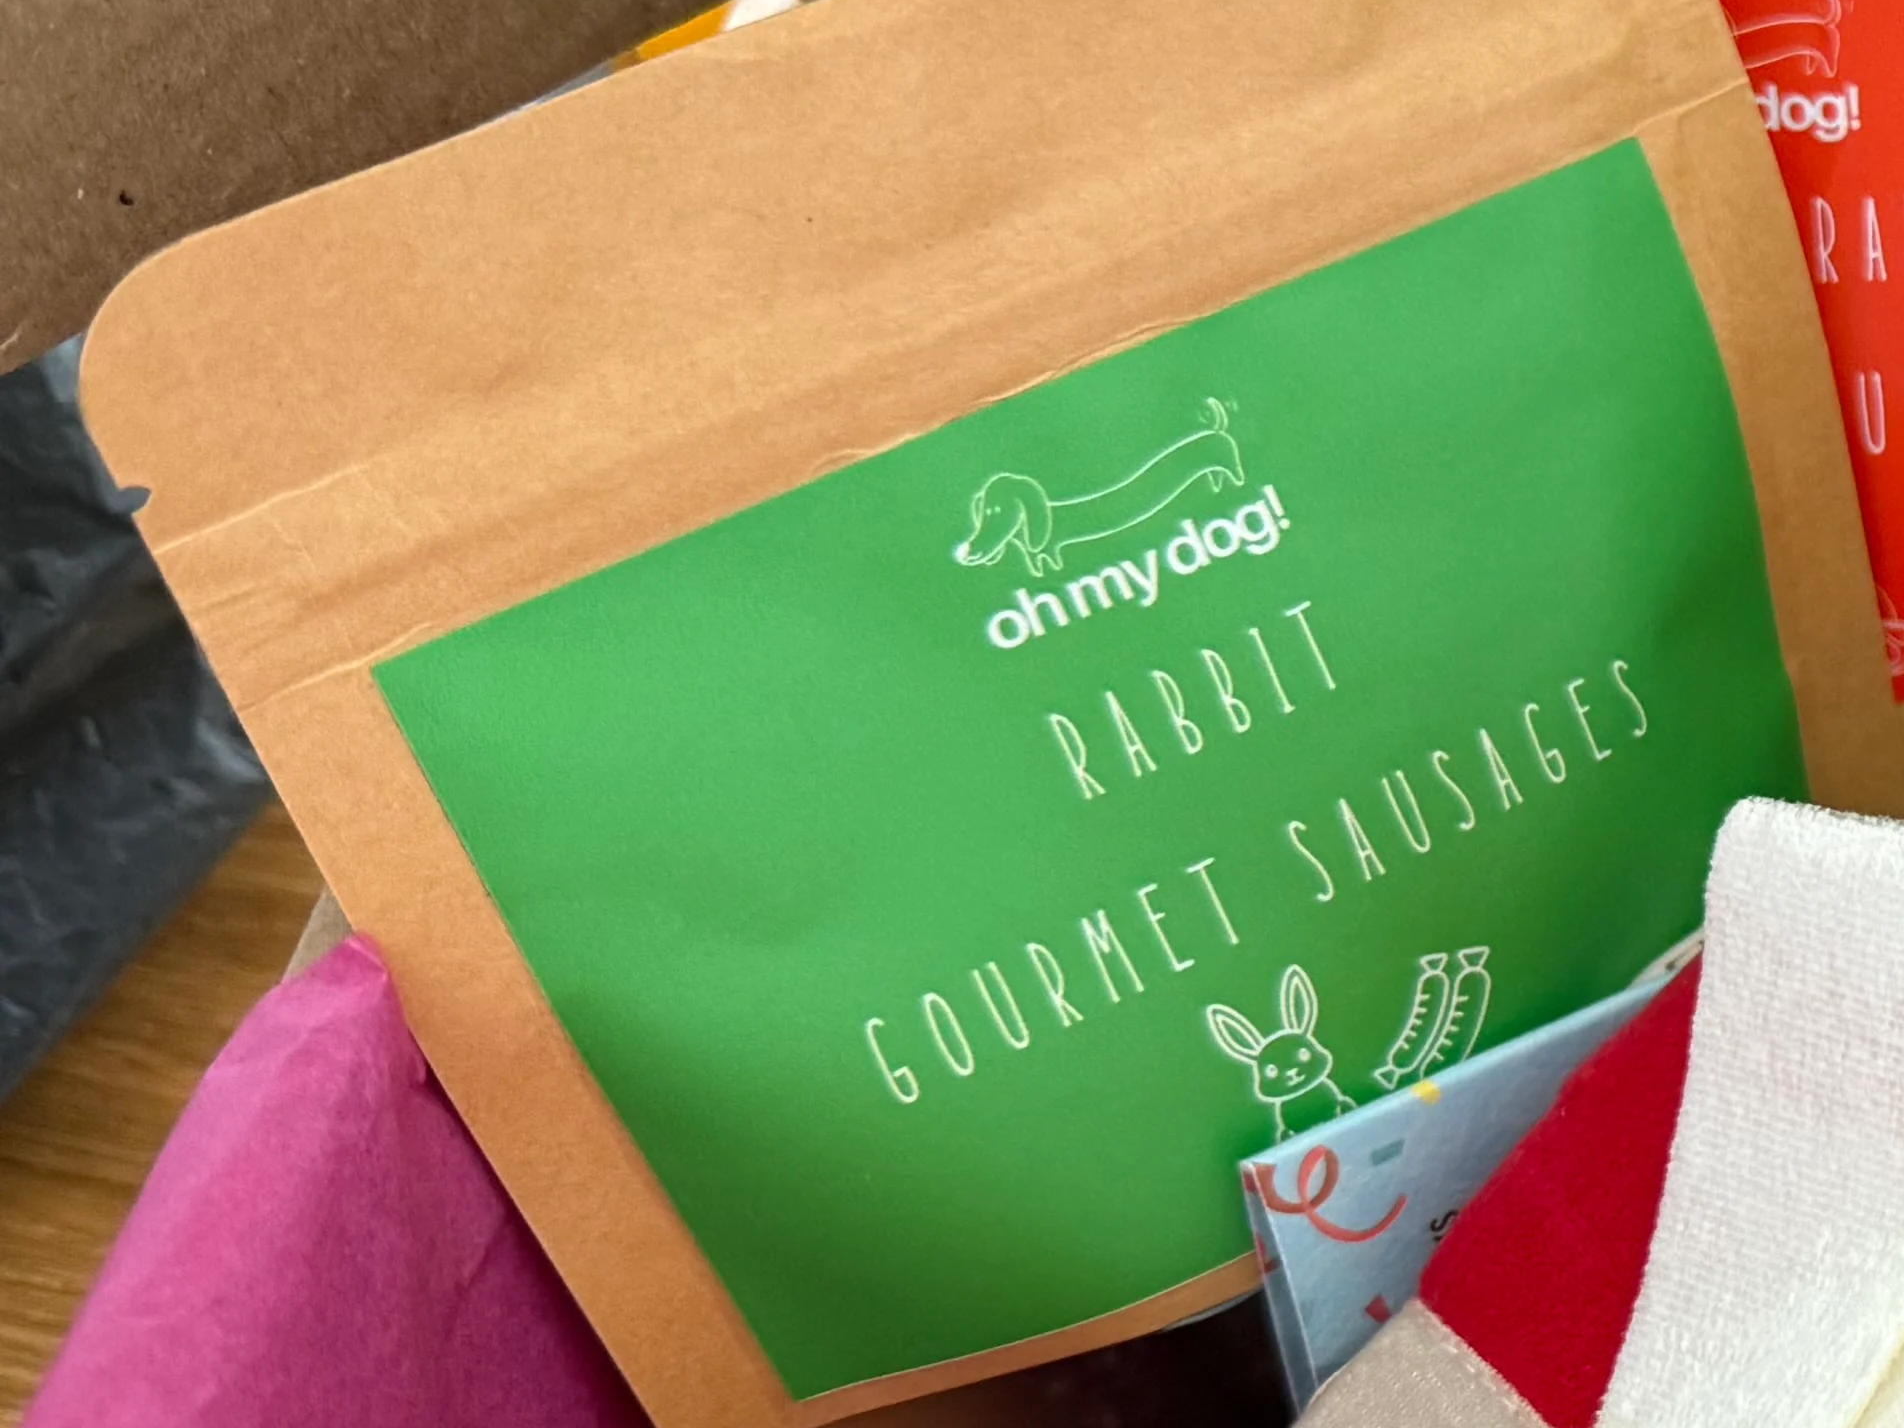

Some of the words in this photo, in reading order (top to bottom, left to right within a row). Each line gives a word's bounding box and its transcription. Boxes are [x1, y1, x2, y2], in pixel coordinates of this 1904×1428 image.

[986, 588, 1067, 649] oh
[1066, 548, 1164, 606] my
[1165, 485, 1291, 574] dog!
[1049, 601, 1336, 799] RABBIT
[865, 858, 1240, 1104] GOURMET
[1286, 660, 1648, 903] SAUSAGES
